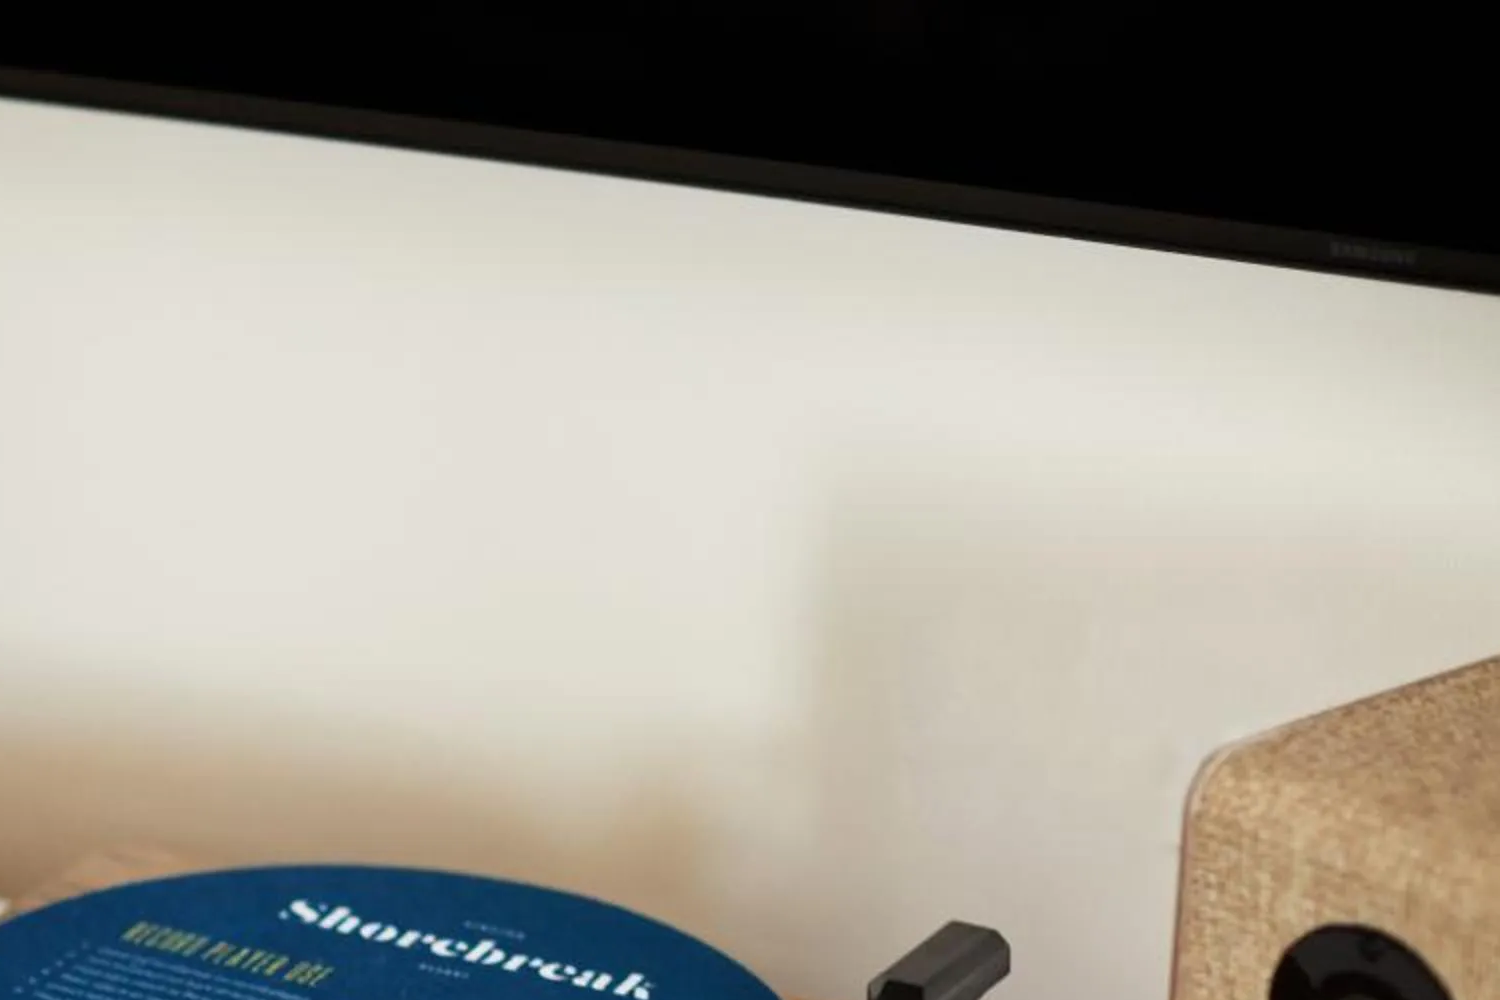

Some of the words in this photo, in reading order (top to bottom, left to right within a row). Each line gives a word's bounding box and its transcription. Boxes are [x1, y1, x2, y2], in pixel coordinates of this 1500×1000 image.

[201, 940, 290, 976] PLAYER
[284, 960, 334, 987] USE
[279, 899, 655, 1000] Shorebreak
